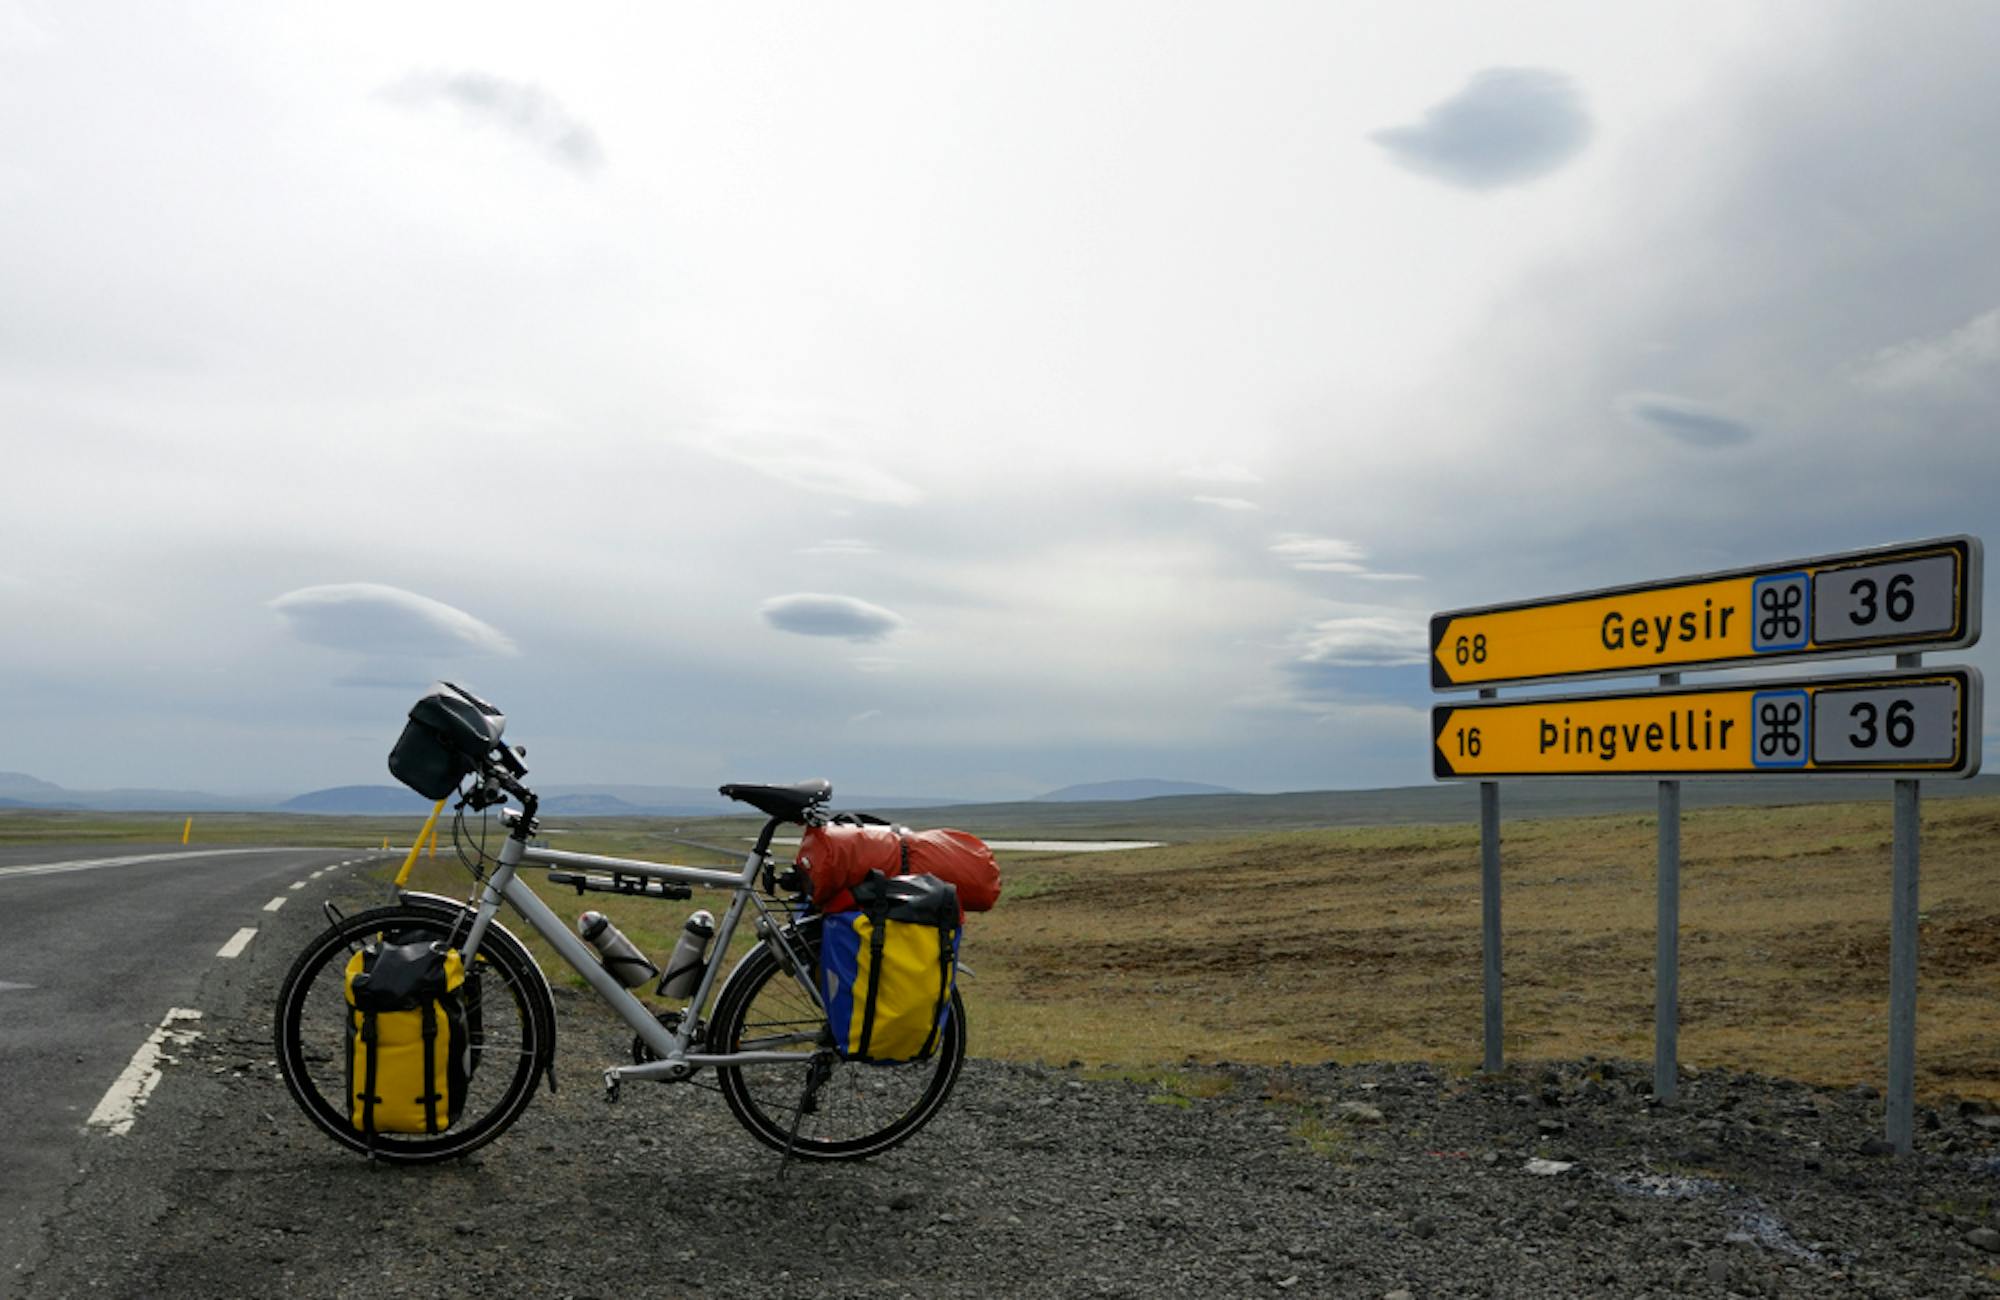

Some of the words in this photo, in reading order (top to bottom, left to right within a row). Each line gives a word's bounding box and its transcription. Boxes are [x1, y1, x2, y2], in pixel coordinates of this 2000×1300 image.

[1455, 634, 1487, 666] 68
[1600, 598, 1735, 654] Geysir
[1848, 573, 1916, 626] 36
[1457, 727, 1482, 759] 16
[1539, 709, 1735, 761] Þingvellir
[1848, 699, 1916, 749] 36
